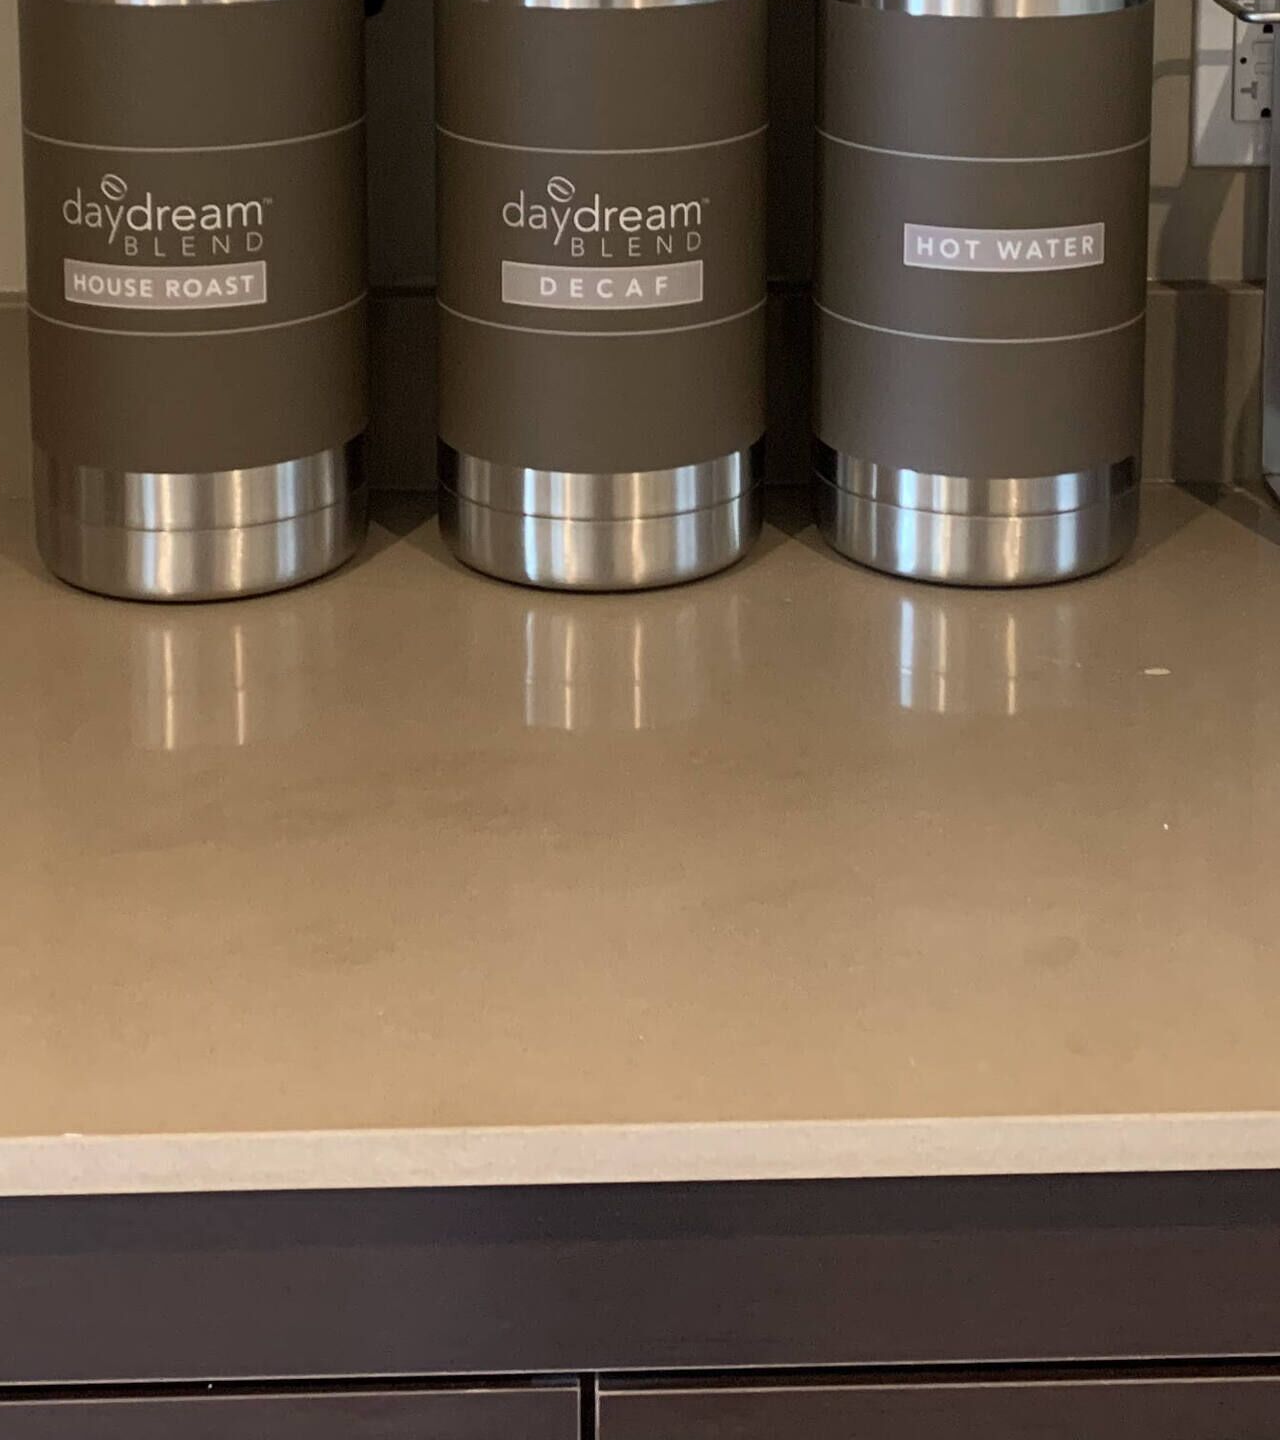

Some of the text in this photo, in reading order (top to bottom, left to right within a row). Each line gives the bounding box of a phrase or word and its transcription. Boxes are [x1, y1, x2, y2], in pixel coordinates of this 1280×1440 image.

[124, 231, 264, 257] BLEND
[571, 231, 702, 258] BLEND
[916, 235, 1095, 261] HOT WATER
[73, 273, 255, 298] HOUSE ROAST
[539, 276, 669, 299] DECAF
